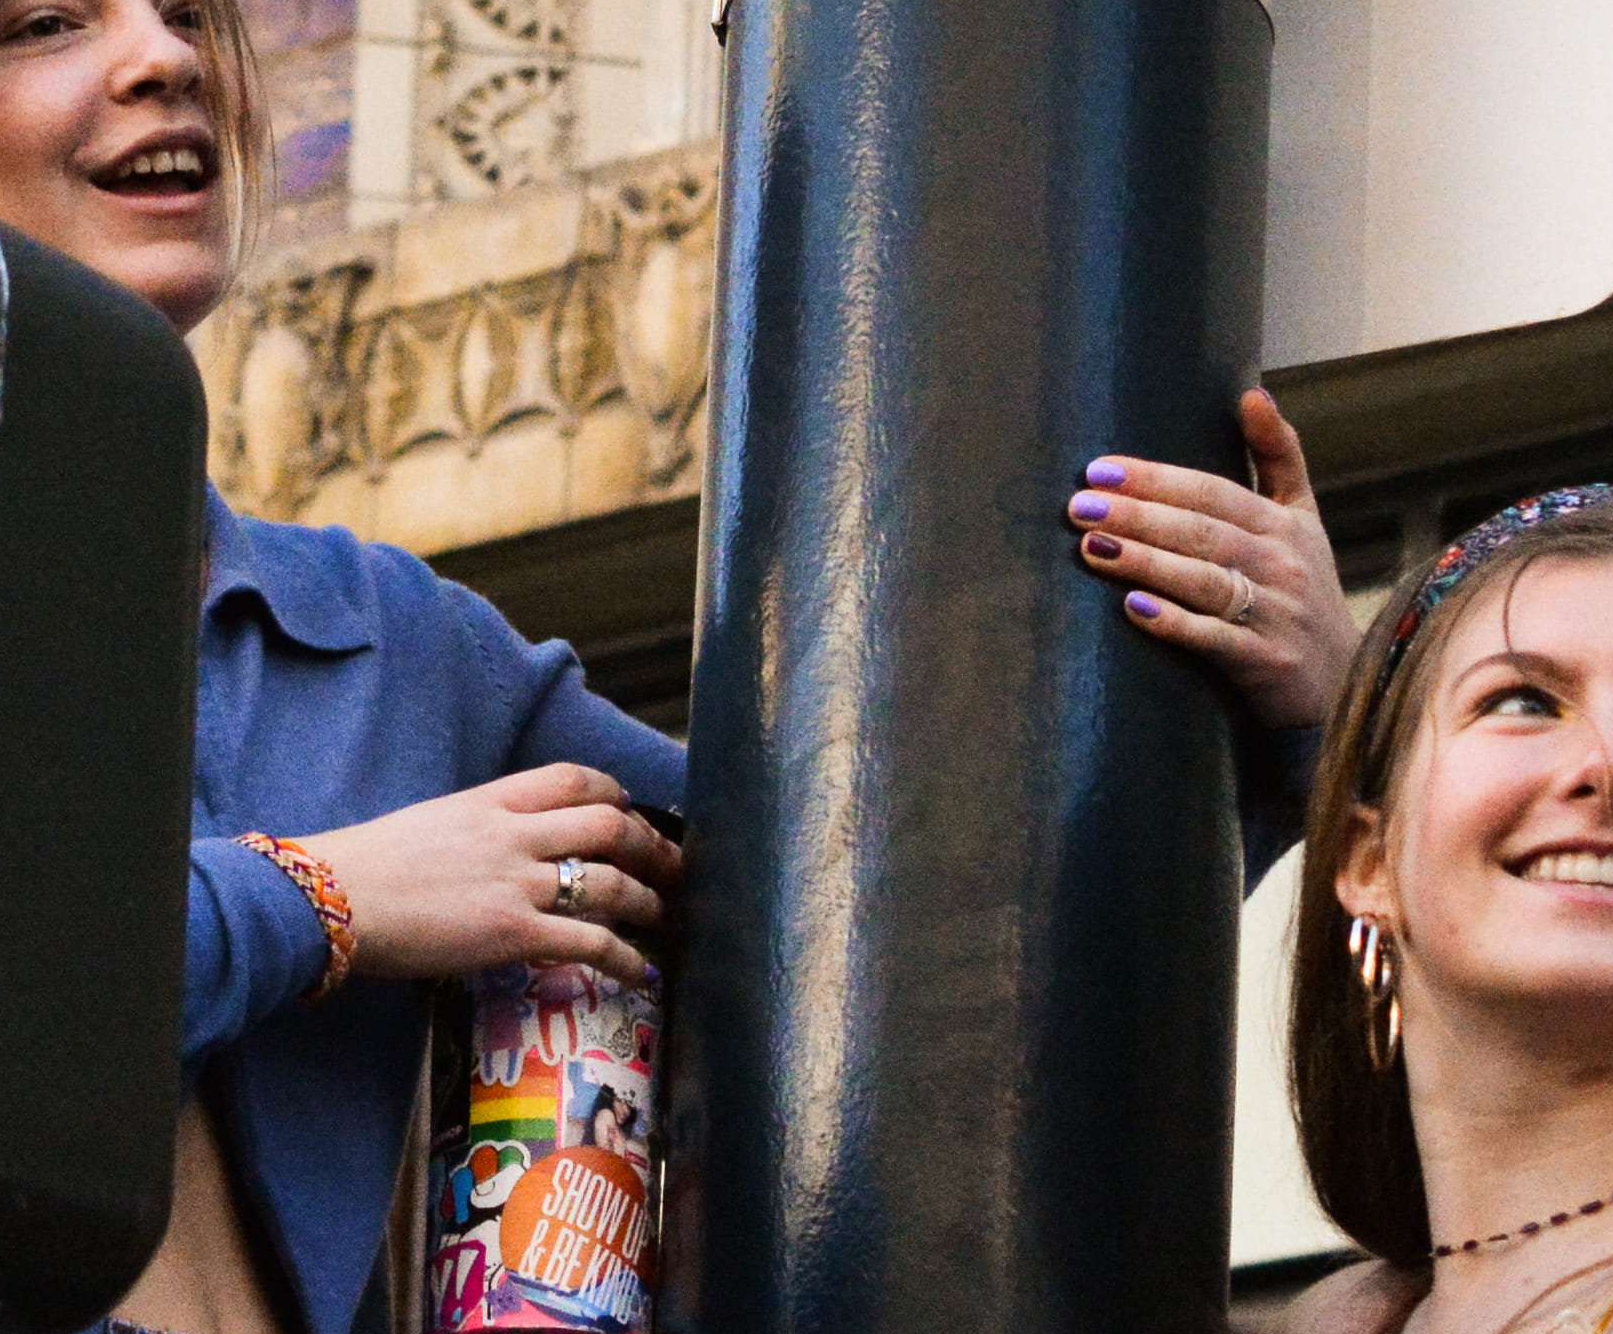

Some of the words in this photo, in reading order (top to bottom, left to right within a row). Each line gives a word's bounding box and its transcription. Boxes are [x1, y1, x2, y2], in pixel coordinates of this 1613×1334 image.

[542, 1158, 630, 1244] SHOW
[518, 1218, 550, 1279] &
[543, 1227, 590, 1292] BE
